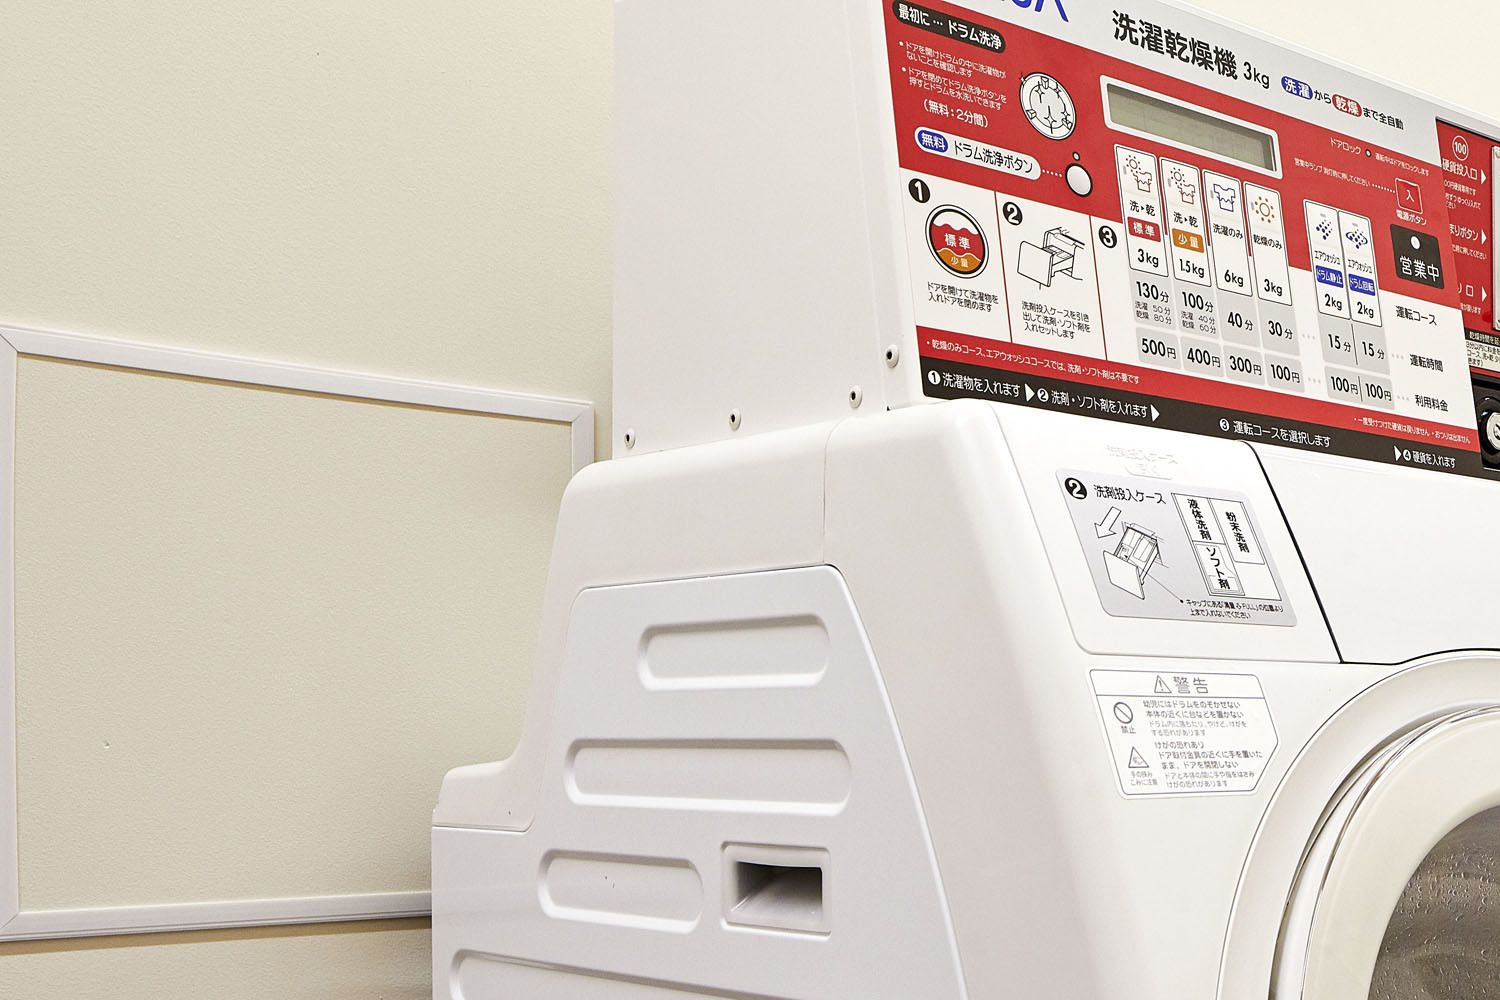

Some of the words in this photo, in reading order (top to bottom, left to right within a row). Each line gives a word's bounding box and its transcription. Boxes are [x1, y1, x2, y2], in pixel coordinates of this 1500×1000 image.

[1112, 10, 1238, 80] 洗濯乾燥機
[1243, 62, 1270, 89] 3kg
[921, 132, 946, 151] 無料
[954, 140, 1034, 174] ドラム洗浄ボタン
[1330, 137, 1362, 155] ドアロック
[1454, 141, 1467, 156] 100
[1406, 190, 1415, 203] 入
[1133, 221, 1155, 237] 標準
[1212, 223, 1244, 240] 洗濯のみ
[944, 232, 971, 250] 標準
[1177, 232, 1200, 248] 少量
[1252, 234, 1283, 250] 乾燥のみ
[950, 256, 969, 268] 少量
[1137, 249, 1159, 268] 3kg
[1179, 258, 1205, 279] 1.5kg
[1224, 269, 1244, 287] 6kg
[1399, 256, 1440, 283] 営業中
[927, 281, 999, 305] ドアを開けて洗濯物を
[1136, 281, 1170, 304] 130分
[1264, 279, 1283, 297] 3kg
[928, 291, 993, 313] 入れドアを閉めます
[1021, 301, 1090, 322] 洗剤投入ケースを引き
[1182, 291, 1215, 313] 100分
[1324, 293, 1343, 311] 2kg
[1356, 301, 1374, 319] 2kg
[1022, 312, 1091, 333] 出して洗剤・ソフト剤を
[1227, 312, 1254, 331] 40分
[1395, 305, 1438, 326] 運転コース
[1024, 322, 1075, 339] 入れセットします
[1268, 320, 1293, 340] 30分
[1141, 338, 1177, 360] 500円
[1328, 333, 1351, 353] 15分
[1361, 340, 1385, 360] 15分
[1187, 347, 1221, 368] 400円
[1229, 355, 1262, 376] 300円
[1409, 353, 1444, 373] 運転時間
[1271, 364, 1301, 384] 100円
[942, 372, 1021, 398] 洗濯物を入れます
[1331, 376, 1359, 395] 100円
[1365, 383, 1392, 401] 100円
[1051, 390, 1148, 418] 洗剤・ソフト剤を入れます
[1414, 394, 1449, 412] 利用料金
[1233, 420, 1331, 447] 運転コースを選択します
[1412, 450, 1456, 469] 硬貨を入れます
[1093, 484, 1167, 504] 洗剤投入ケース
[1187, 498, 1212, 541] 液体洗剤
[1225, 511, 1250, 553] 粉末洗剤
[1206, 547, 1231, 590] ソフト剤
[1173, 676, 1208, 694] 警告
